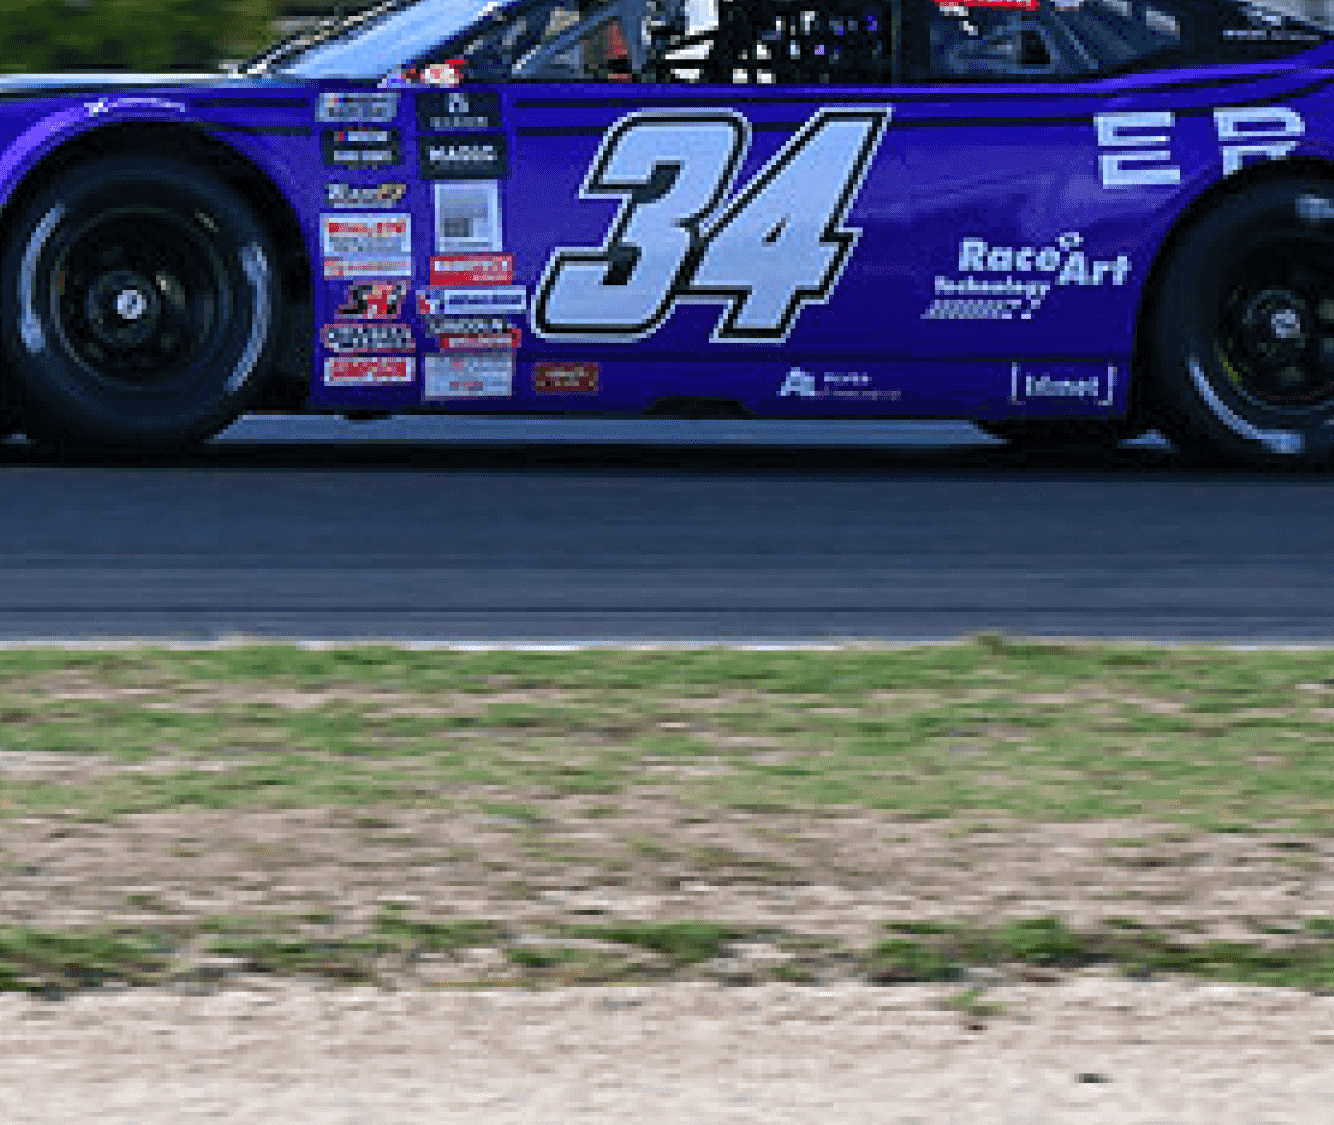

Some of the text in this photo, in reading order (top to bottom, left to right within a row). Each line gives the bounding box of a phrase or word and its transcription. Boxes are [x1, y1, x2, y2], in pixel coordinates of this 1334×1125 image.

[531, 107, 892, 342] 34
[958, 237, 1131, 286] Race Art
[934, 276, 1051, 297] Technology
